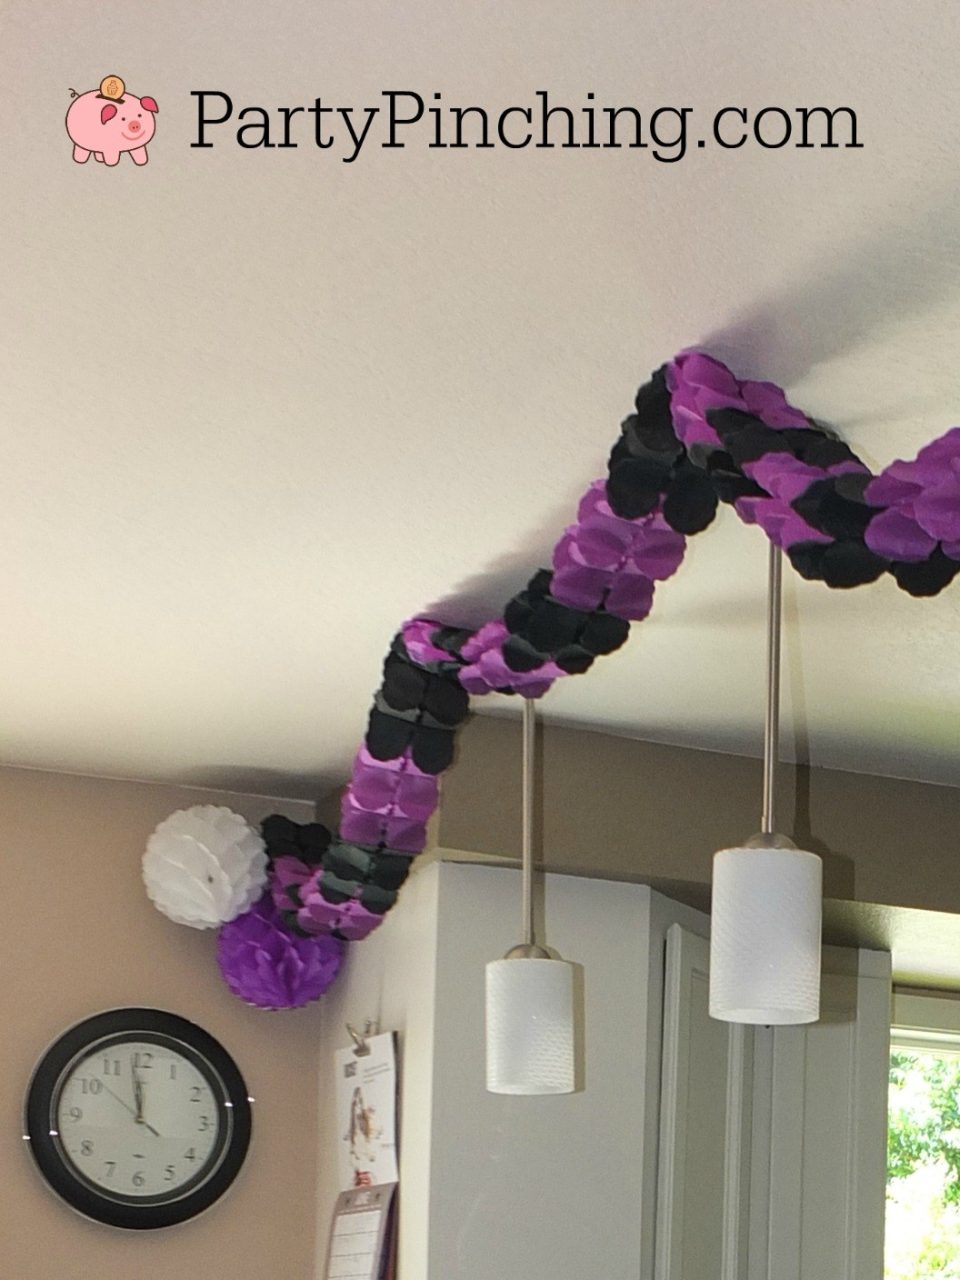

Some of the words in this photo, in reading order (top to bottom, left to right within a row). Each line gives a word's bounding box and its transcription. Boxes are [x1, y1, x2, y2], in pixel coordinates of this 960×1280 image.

[103, 1059, 121, 1076] 11
[134, 1052, 153, 1069] 12
[169, 1064, 177, 1080] 1
[80, 1078, 103, 1095] 10
[189, 1086, 201, 1103] 2
[69, 1107, 83, 1122] 9
[197, 1115, 210, 1132] 3
[81, 1140, 94, 1156] 8
[184, 1148, 196, 1162] 4
[104, 1161, 117, 1177] 7
[164, 1165, 175, 1181] 5
[132, 1171, 145, 1187] 6
